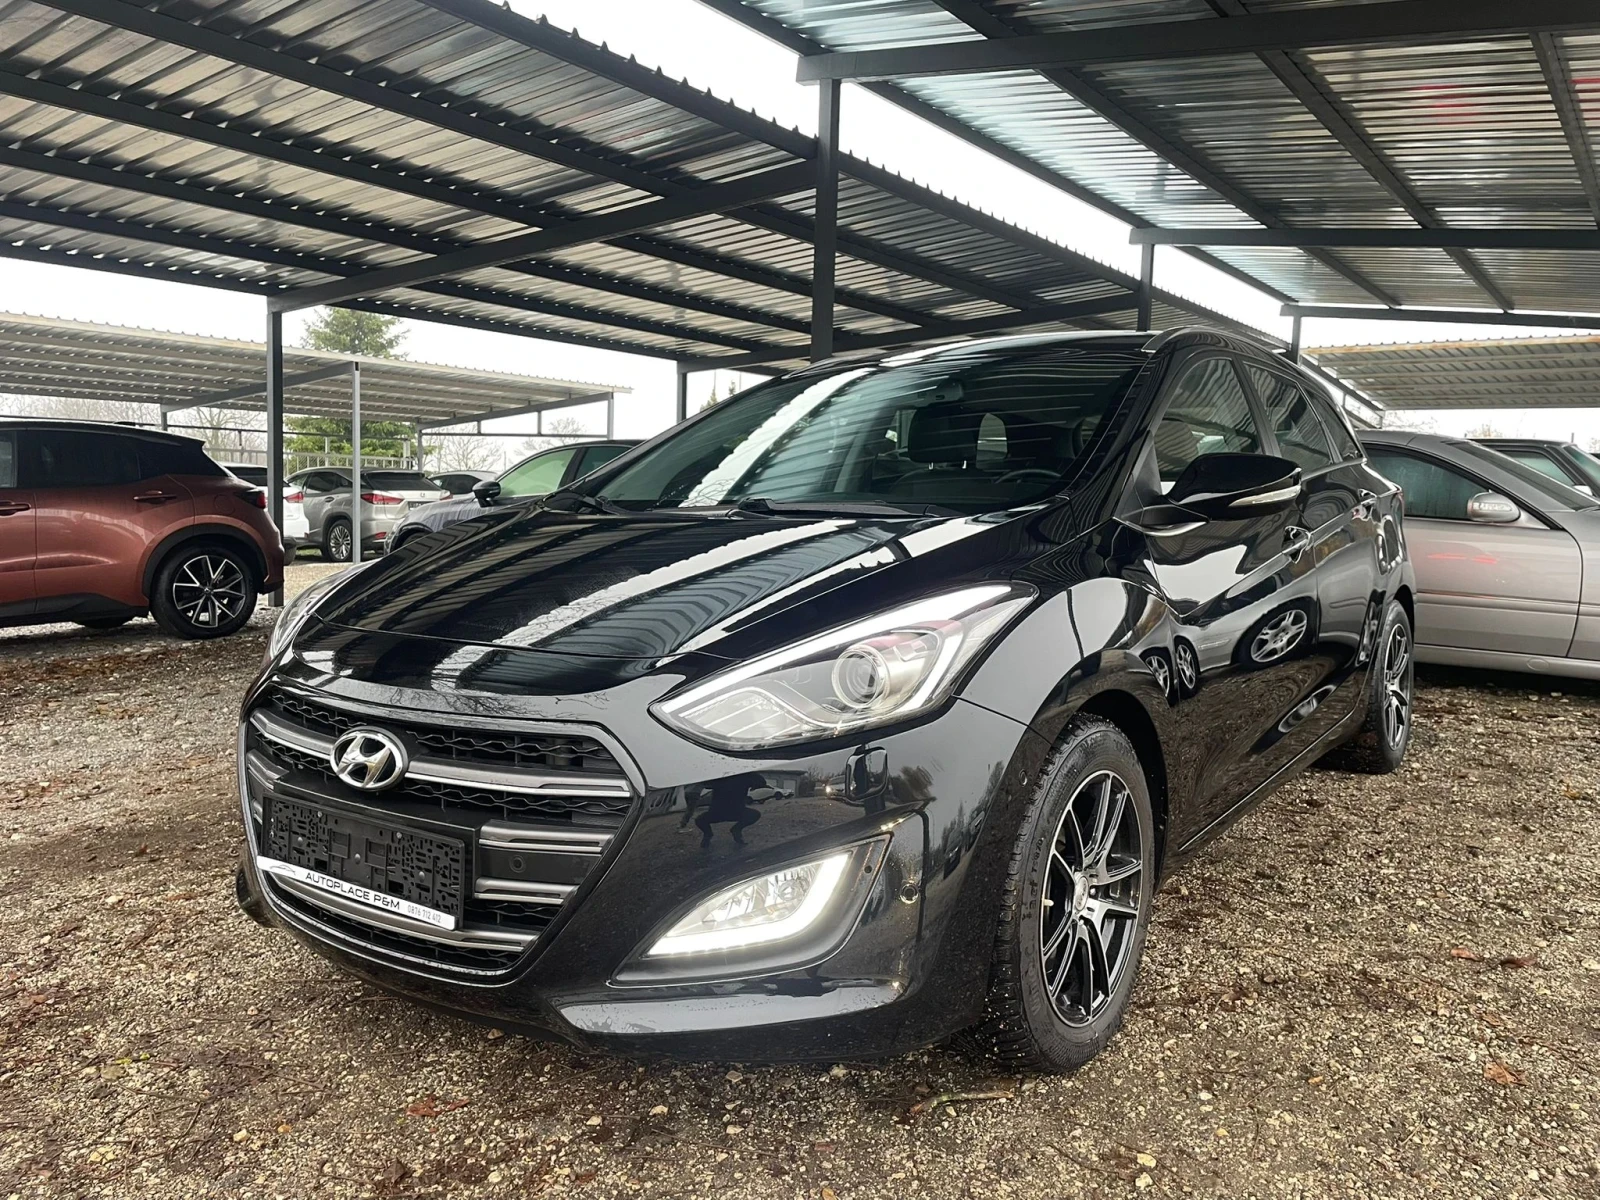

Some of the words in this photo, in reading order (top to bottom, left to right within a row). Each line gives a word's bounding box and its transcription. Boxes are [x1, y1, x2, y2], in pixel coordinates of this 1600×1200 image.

[305, 872, 371, 901] AUTOPLACE
[373, 894, 400, 910] P&M
[407, 904, 421, 917] 0876
[422, 909, 431, 920] 712
